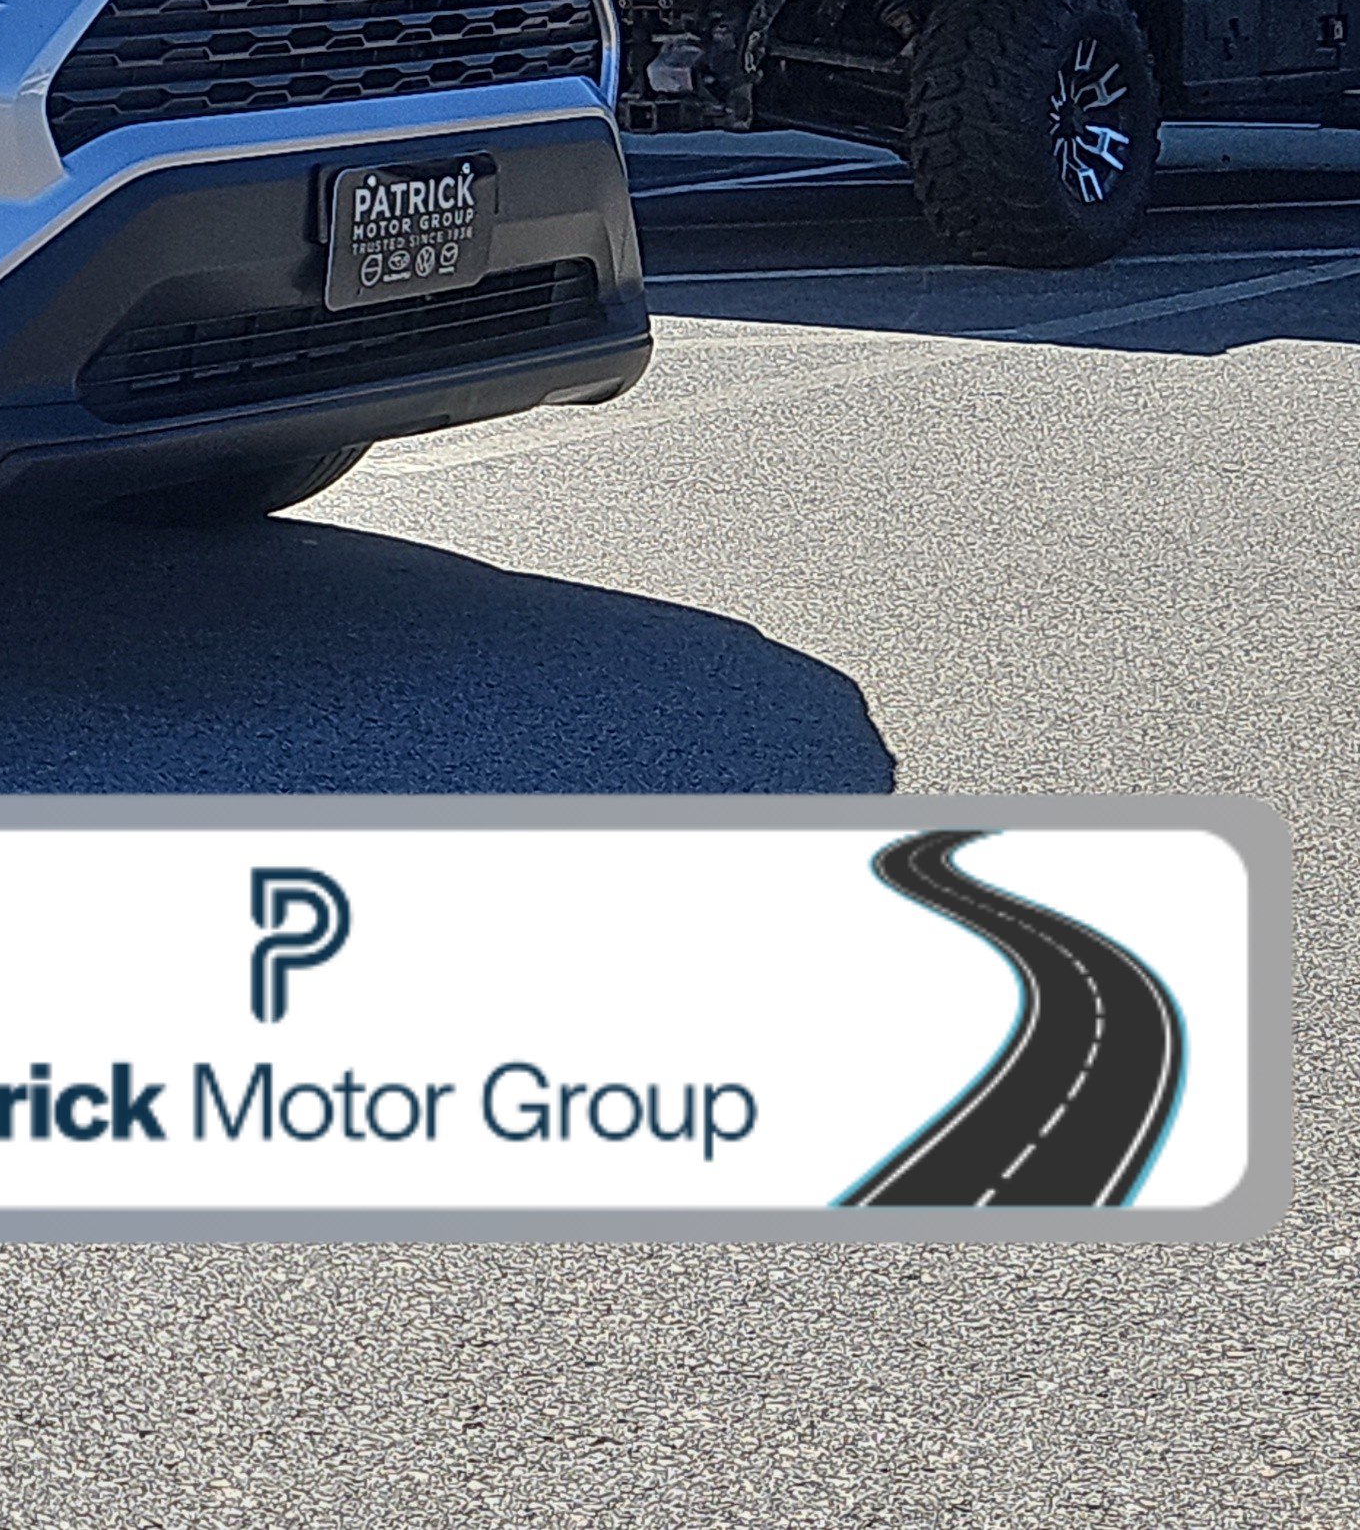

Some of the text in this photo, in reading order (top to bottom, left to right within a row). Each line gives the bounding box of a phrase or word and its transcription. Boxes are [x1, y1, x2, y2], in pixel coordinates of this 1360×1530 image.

[354, 173, 475, 222] PATRICK
[352, 208, 475, 241] MOTOR GROUP
[352, 237, 406, 256] TRUSTED
[409, 230, 444, 248] SINCE
